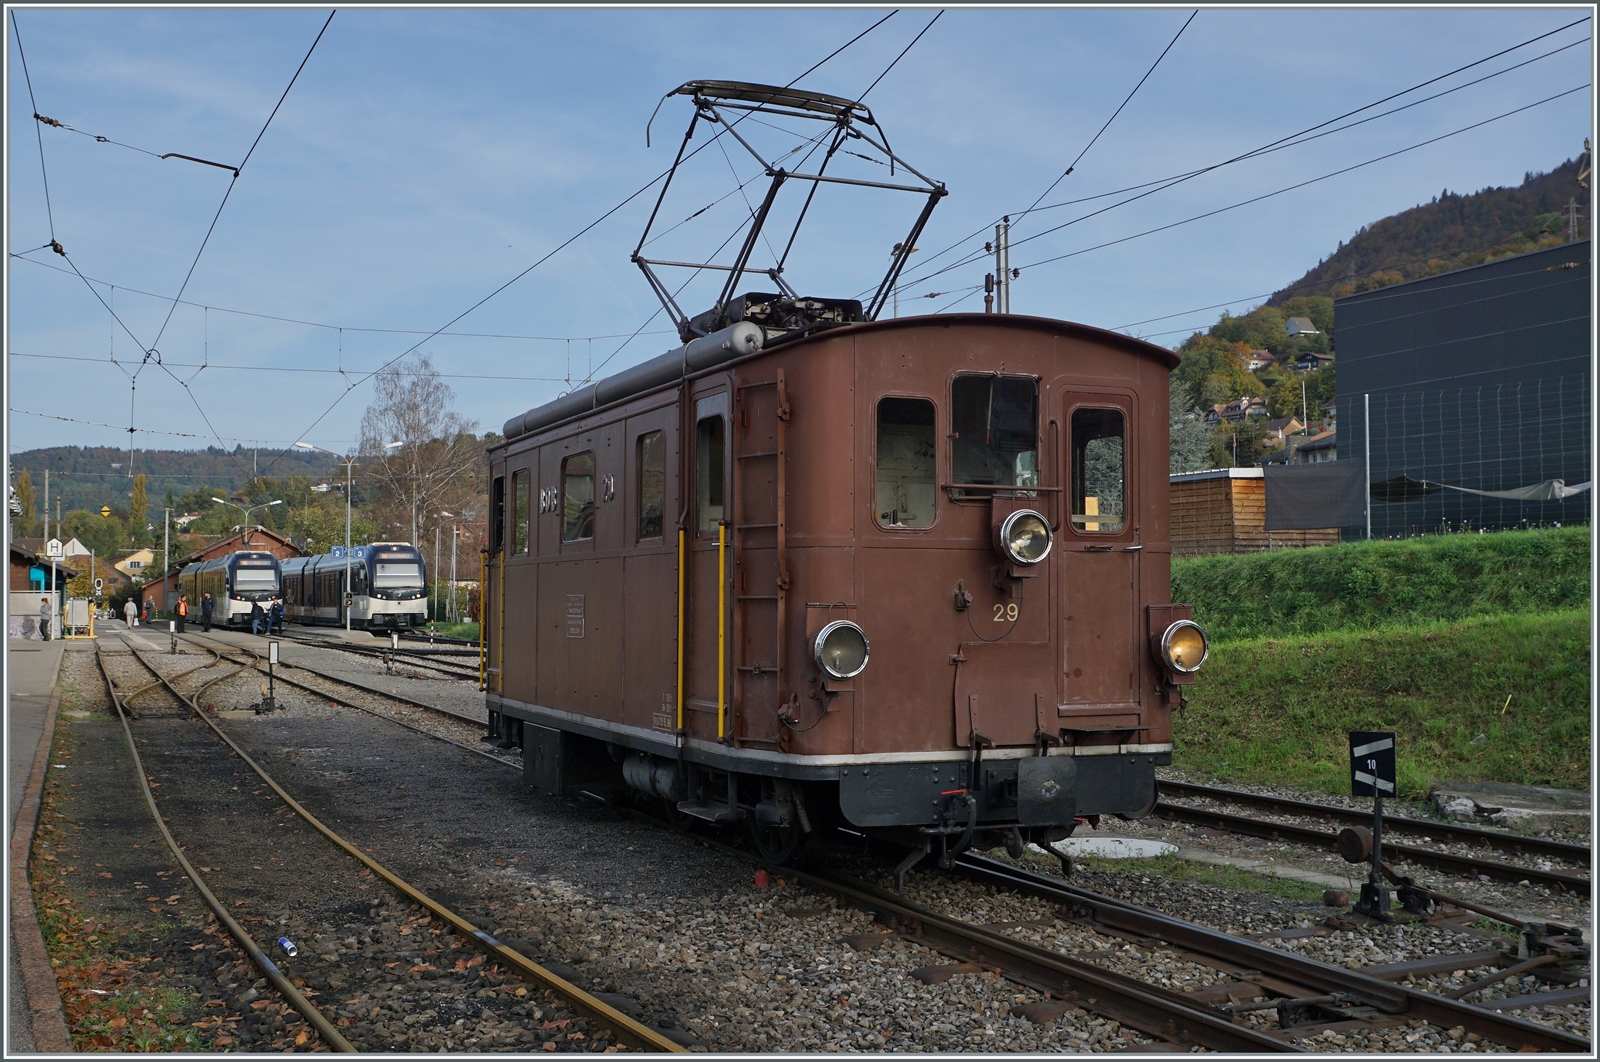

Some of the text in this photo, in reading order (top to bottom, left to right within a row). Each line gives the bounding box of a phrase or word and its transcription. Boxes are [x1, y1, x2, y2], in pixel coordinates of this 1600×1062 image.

[50, 542, 59, 552] H
[993, 603, 1019, 622] 29
[1366, 758, 1377, 770] 10
